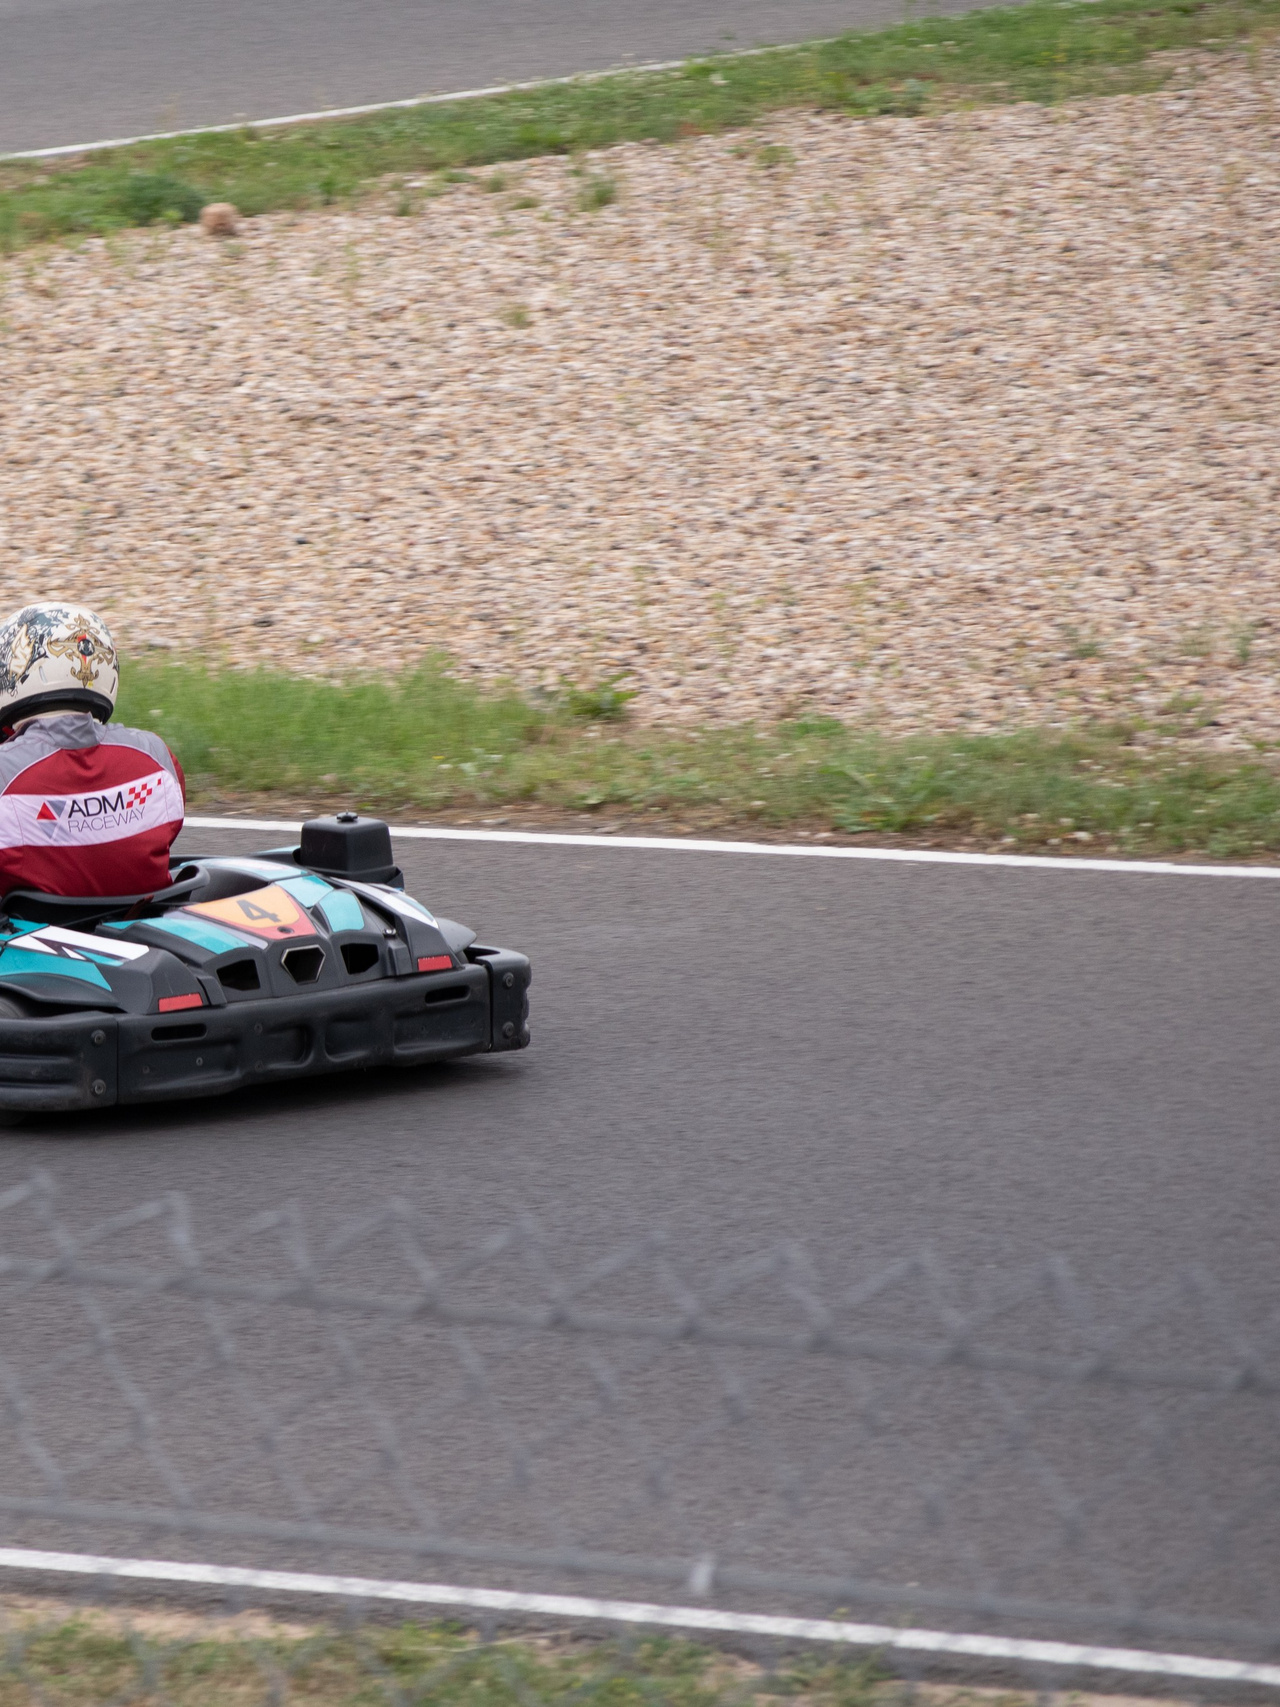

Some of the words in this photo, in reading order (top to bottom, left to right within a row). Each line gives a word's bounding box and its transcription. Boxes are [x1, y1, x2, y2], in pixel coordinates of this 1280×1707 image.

[68, 791, 125, 819] ADM
[67, 806, 146, 833] RACEWAY
[236, 899, 281, 923] 4
